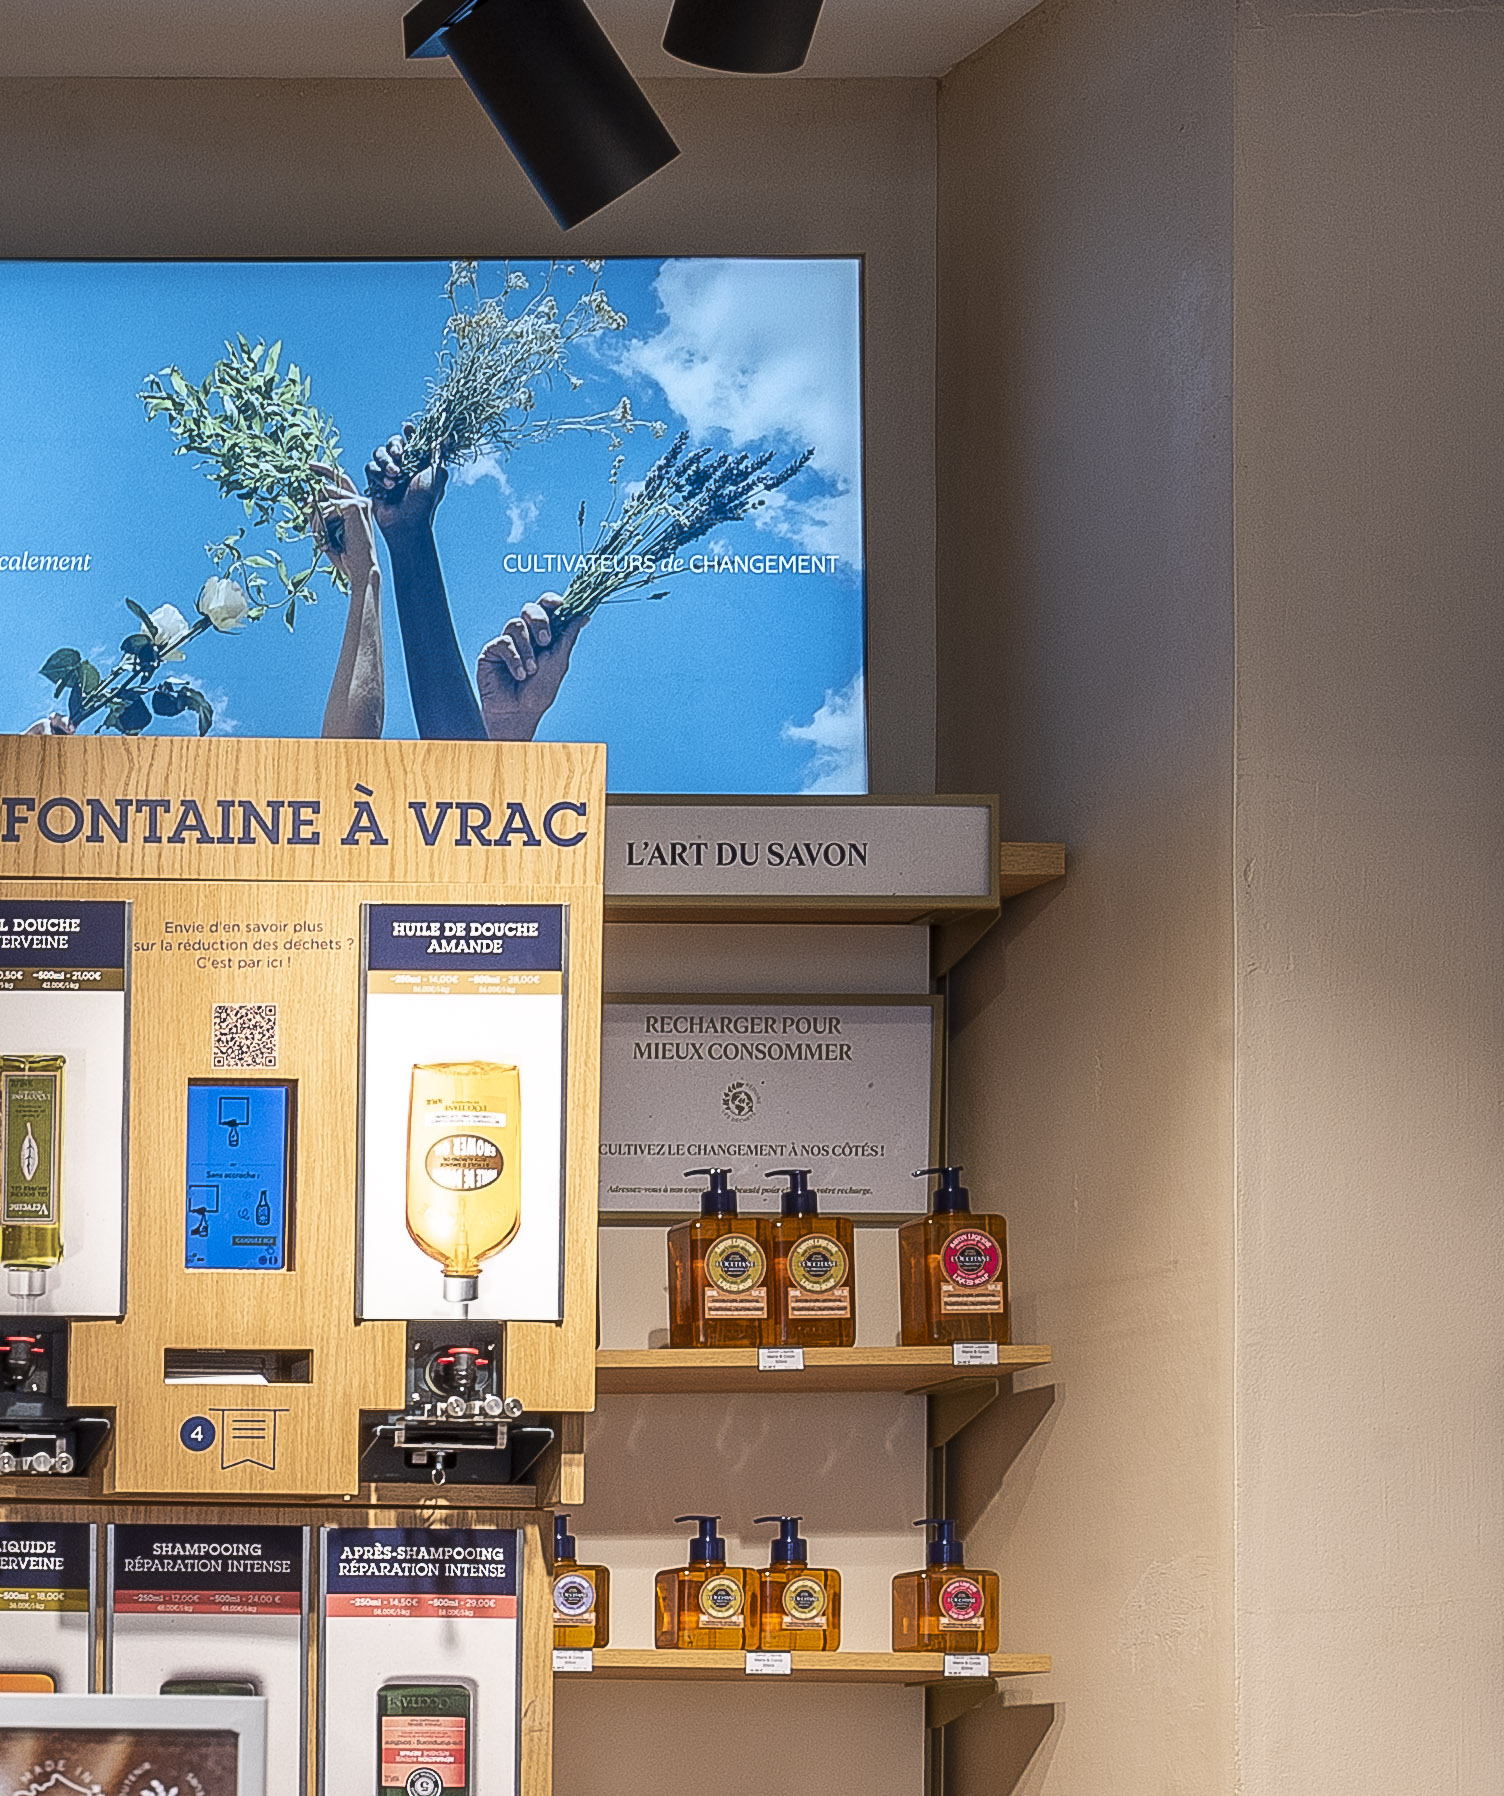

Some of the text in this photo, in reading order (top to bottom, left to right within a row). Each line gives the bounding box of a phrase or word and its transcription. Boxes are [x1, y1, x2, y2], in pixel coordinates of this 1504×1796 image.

[502, 551, 839, 574] CULTIVATEURS de CHANGEMENT
[0, 796, 321, 845] FONTAINE
[341, 782, 388, 846] À
[408, 799, 589, 848] VRAC
[626, 841, 869, 868] L'ART DU SAVON
[13, 919, 80, 932] DOUCHE
[165, 921, 323, 936] Envie d'en savoir plus
[392, 922, 538, 936] HUILE DE DOUCHE
[134, 937, 342, 951] sur la réduction des déchets
[427, 939, 503, 954] AMANDE
[197, 956, 283, 972] C'est par ici
[645, 1015, 841, 1035] RECHARGER POUR
[632, 1042, 853, 1061] MIEUX CONSOMMER
[598, 1143, 667, 1157] CULTIVEZ
[668, 1144, 685, 1157] LE
[687, 1144, 787, 1157] CHANGEMENT
[788, 1141, 799, 1157] À
[801, 1144, 829, 1157] NOS
[152, 1543, 262, 1556] SHAMPOOING
[340, 1542, 504, 1560] APRÈS-SHAMPOOING
[124, 1557, 291, 1573] RÉPARATION INTENSE
[338, 1560, 506, 1577] RÉPARATION INTENSE
